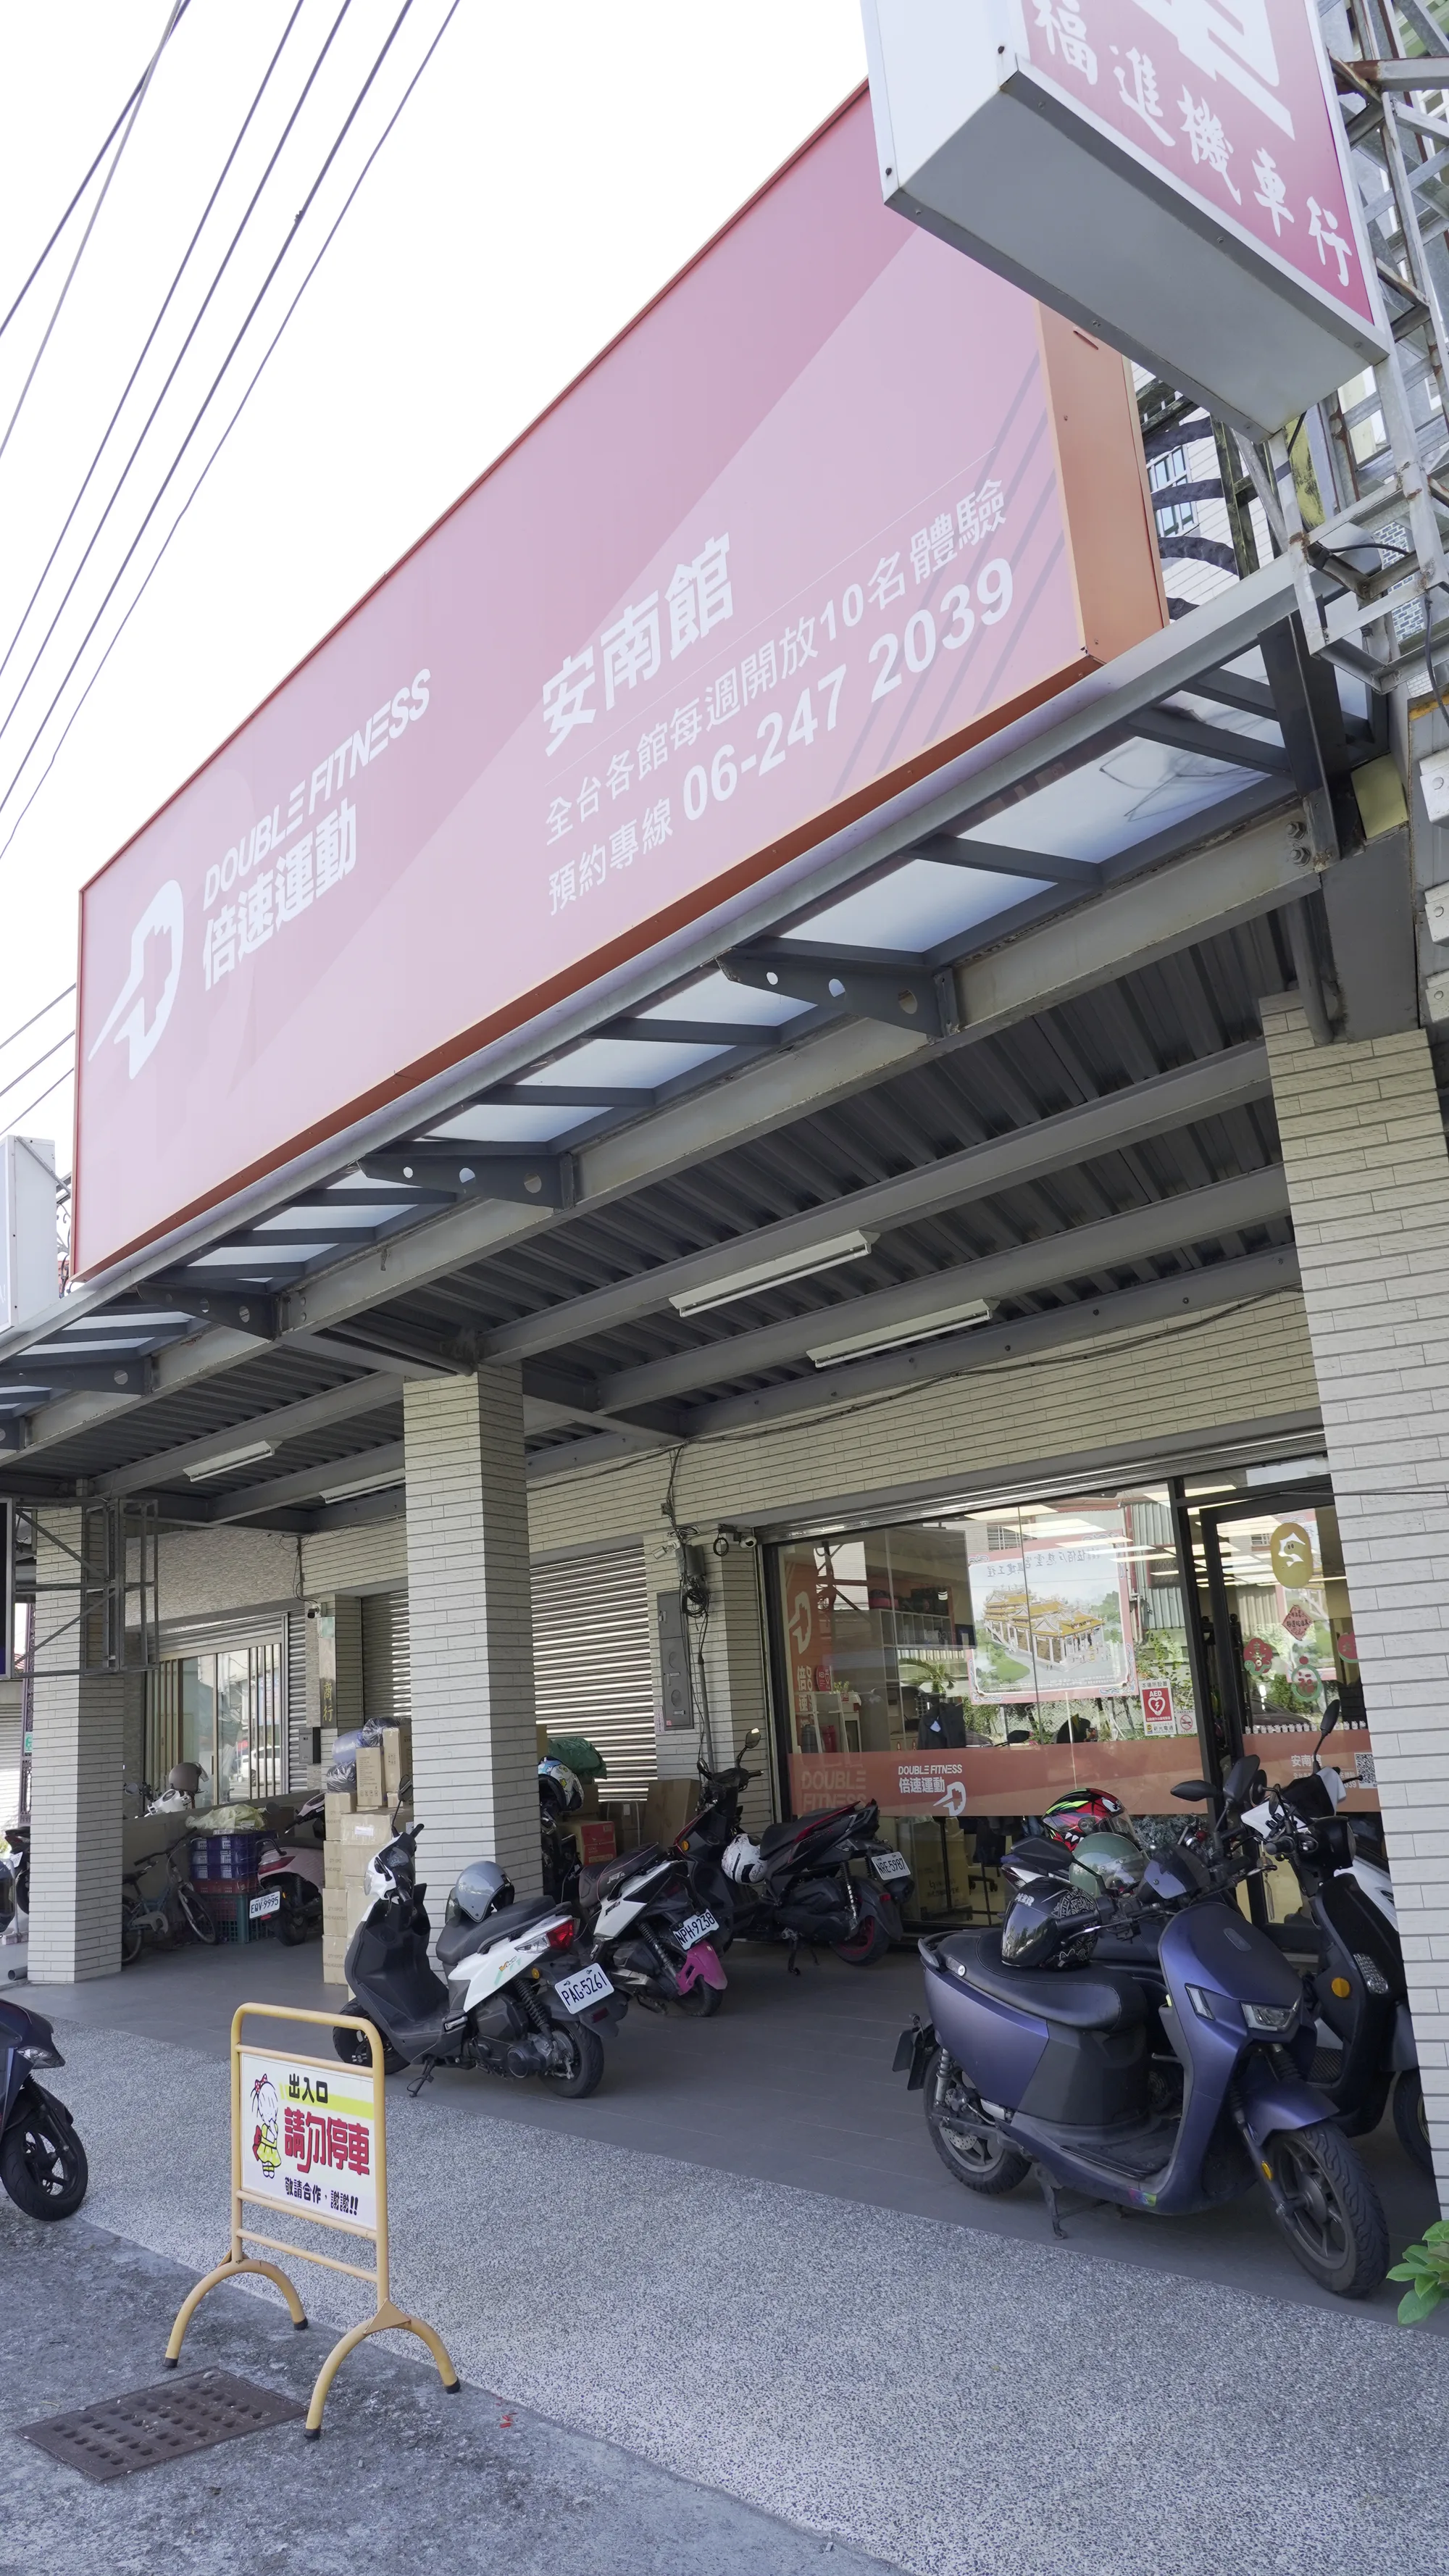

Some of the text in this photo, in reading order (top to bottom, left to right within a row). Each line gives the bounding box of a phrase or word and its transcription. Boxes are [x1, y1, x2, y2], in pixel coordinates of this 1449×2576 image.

[1035, 0, 1352, 287] 福進機車行
[542, 532, 734, 757] 安南館
[546, 479, 1007, 846] 全台各館每週開放10名體驗
[548, 558, 1014, 917] 預約專線 06-247 2039
[203, 668, 431, 912] DOUBLE FITNESS
[203, 798, 356, 991] 倍速運動
[323, 1682, 333, 1722] 商行
[801, 1770, 867, 1790] DOUBLE
[898, 1764, 963, 1775] DOUBLE FITNESS
[899, 1777, 945, 1793] 倍速運動
[251, 1896, 279, 1914] EQV-9995
[675, 1912, 715, 1946] NPH-9238
[561, 1972, 608, 2006] PAG-5261
[288, 2073, 328, 2104] 出入口
[284, 2106, 370, 2175] 請勿停車
